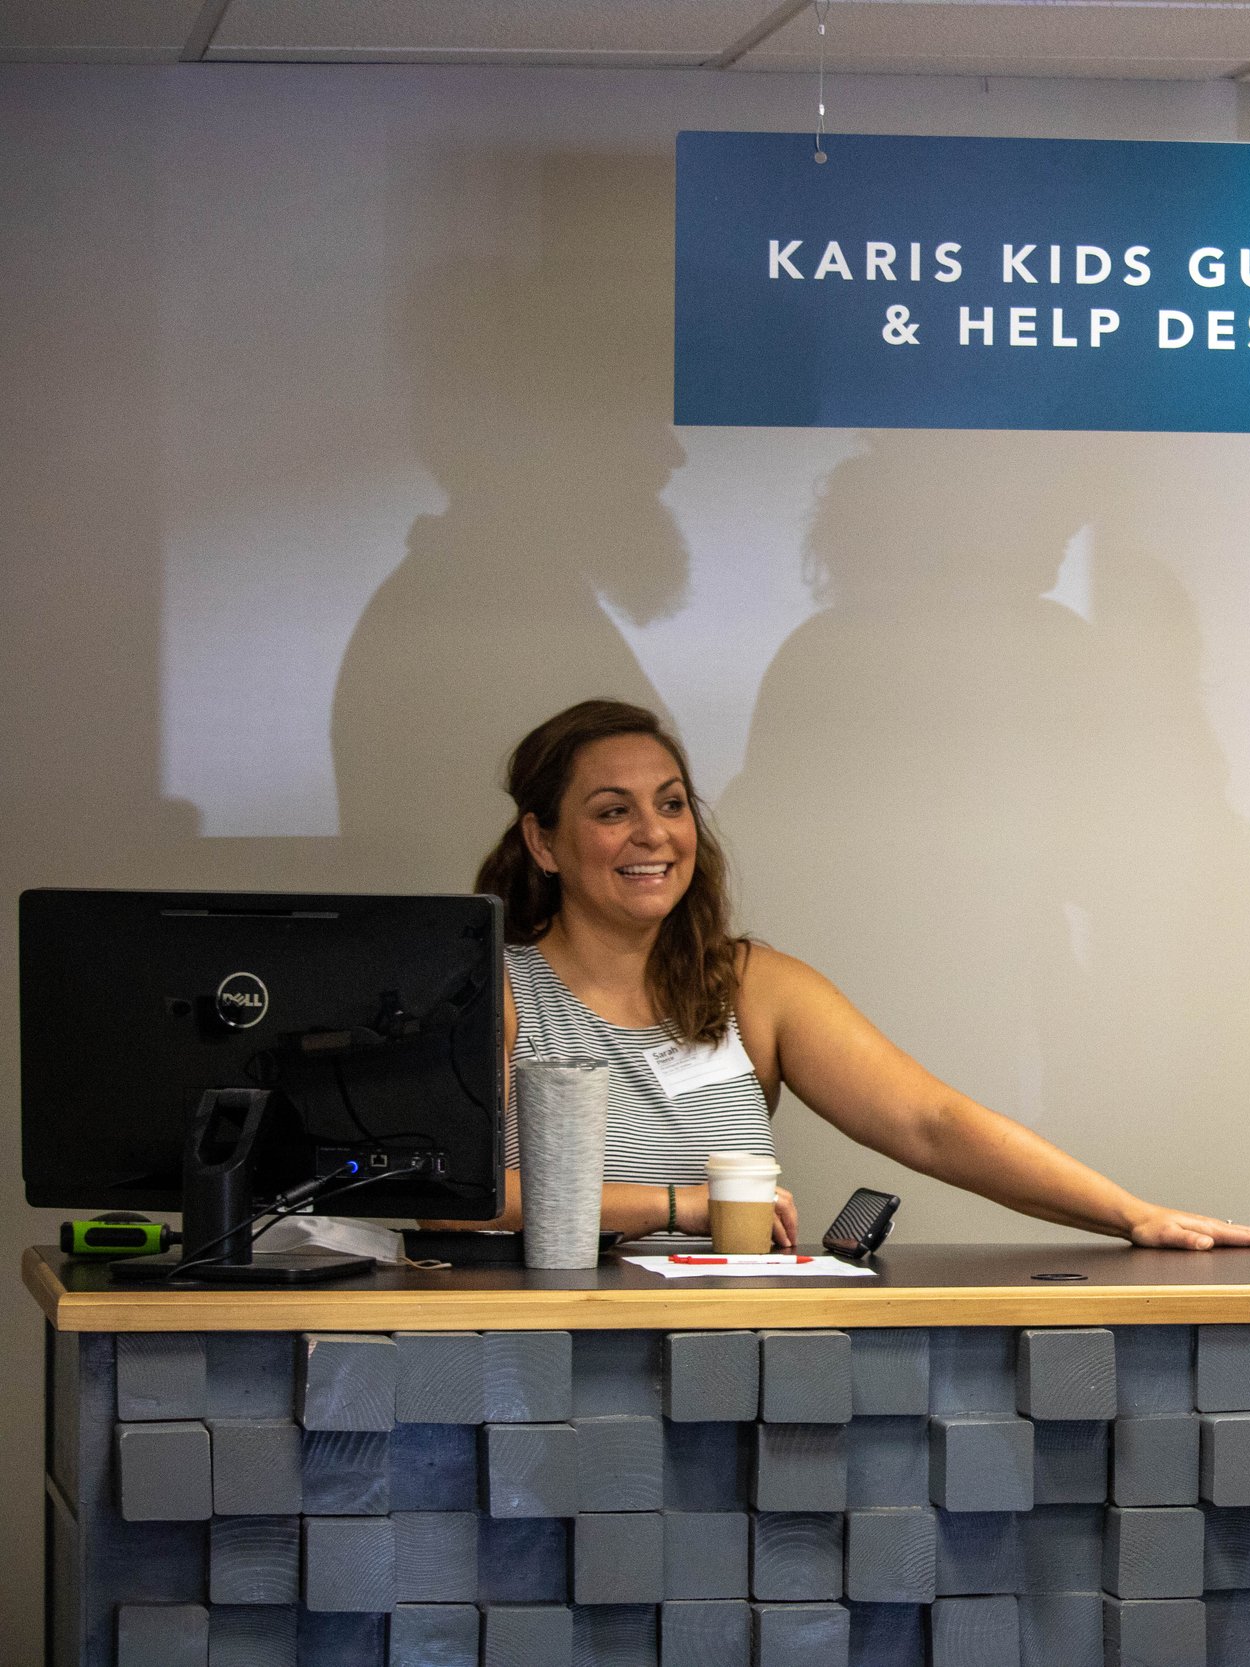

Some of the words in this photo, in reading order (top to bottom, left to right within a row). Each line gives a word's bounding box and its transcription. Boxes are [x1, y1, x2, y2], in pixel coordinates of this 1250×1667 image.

[768, 239, 963, 283] KARIS
[1002, 243, 1151, 287] KIDS
[881, 304, 921, 346] &
[959, 306, 1120, 348] HELP
[222, 992, 263, 1008] DELL
[652, 1047, 679, 1060] Sarah
